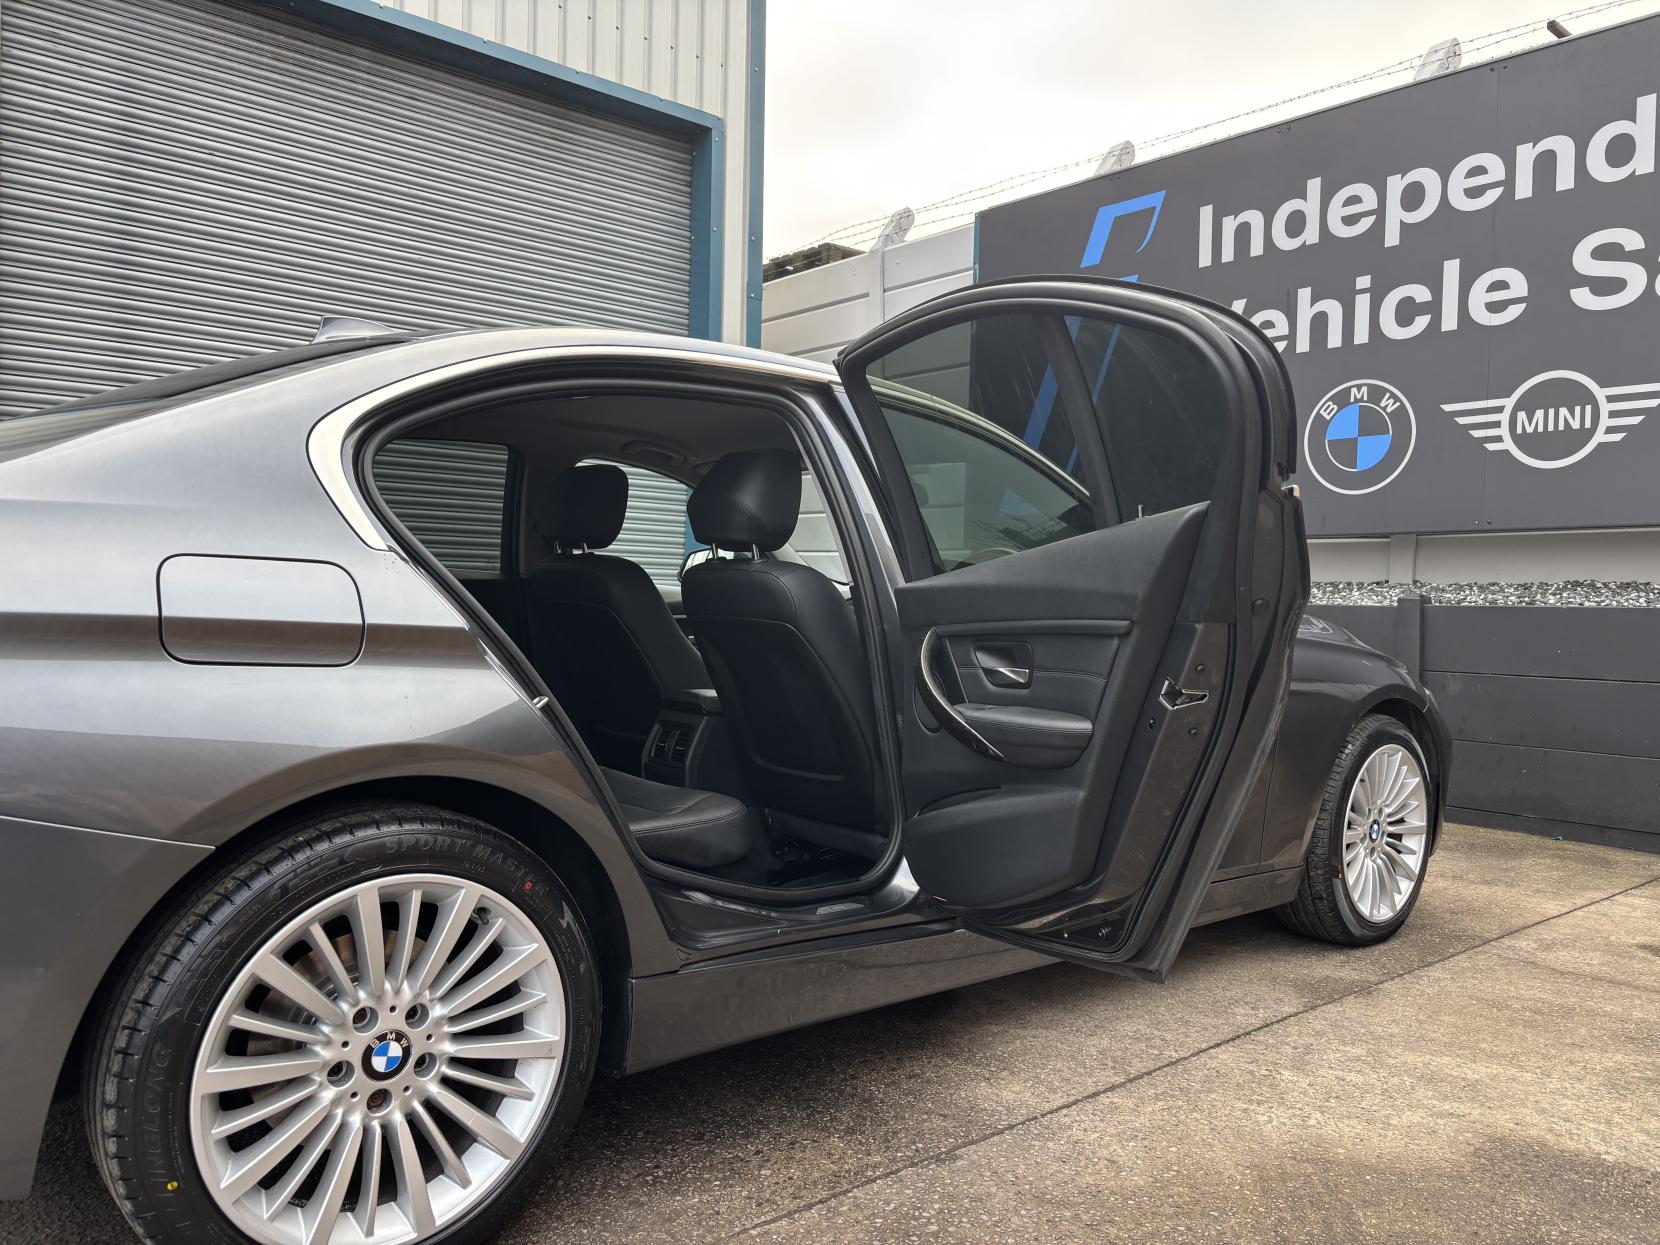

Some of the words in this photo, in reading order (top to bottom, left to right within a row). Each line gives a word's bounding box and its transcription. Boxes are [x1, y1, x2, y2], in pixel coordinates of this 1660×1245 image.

[1199, 93, 1657, 269] Independ
[1231, 259, 1529, 354] ehicle
[1569, 227, 1660, 311] S
[1319, 385, 1401, 421] BMW
[1516, 404, 1592, 434] MINI
[370, 1031, 409, 1049] BMW
